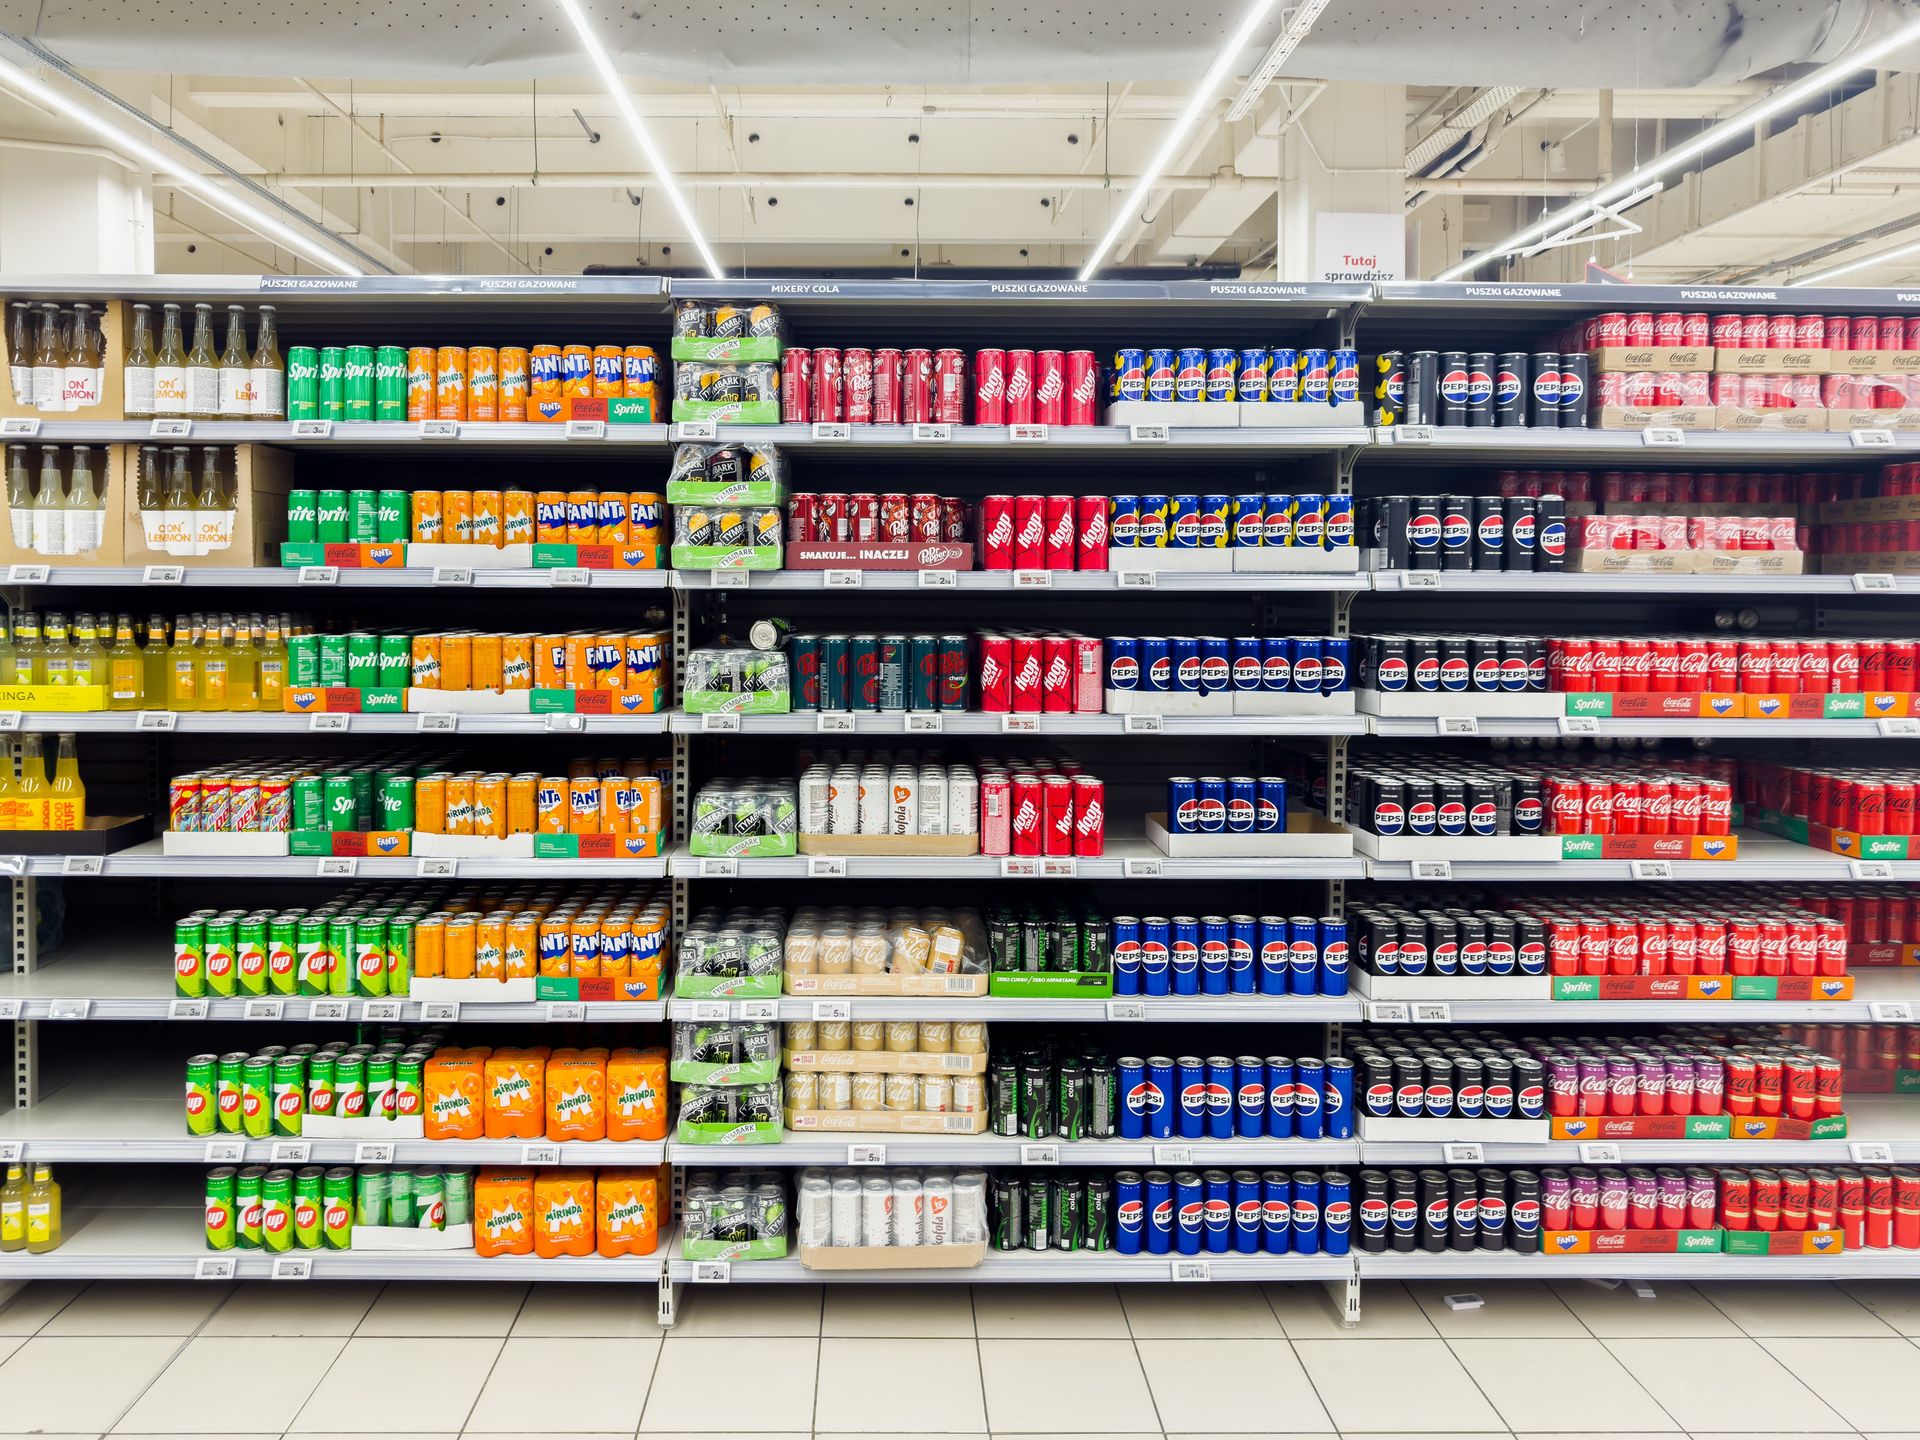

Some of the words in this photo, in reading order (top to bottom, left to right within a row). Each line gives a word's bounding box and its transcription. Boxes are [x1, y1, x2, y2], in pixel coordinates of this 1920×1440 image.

[1343, 256, 1377, 268] Tutaj
[1325, 271, 1393, 282] sprawdzisz
[261, 280, 297, 288] PUSZKI
[480, 281, 516, 289] PUSZKI
[518, 281, 577, 289] GAZOWANE
[771, 285, 810, 293] MIXERY
[812, 285, 839, 293] COLA
[992, 284, 1027, 293] PUSZKI
[1028, 285, 1088, 293] GAZOWANE
[1210, 286, 1247, 294] PUSZKI
[1249, 286, 1307, 295] GAZOWANE
[1466, 287, 1501, 297] PUSZKI
[1503, 289, 1561, 297] GAZOWANE
[1681, 291, 1716, 299] PUSZKI
[1718, 292, 1777, 300] GAZOWANE
[69, 380, 84, 389] ON
[159, 380, 174, 389] ON
[539, 402, 562, 413] FANTA
[614, 403, 645, 416] Sprite
[370, 548, 393, 559] FANTA
[622, 550, 645, 561] FANTA
[721, 549, 753, 566] TYMBARK
[860, 550, 909, 559] INACZEJ
[920, 550, 948, 564] Pepper
[294, 694, 316, 703] FANTA
[366, 694, 398, 706] Sprite
[620, 695, 643, 705] FANTA
[722, 694, 752, 711] TYMBARK
[1711, 698, 1733, 707] FANTA
[1874, 696, 1896, 706] FANTA
[1575, 699, 1604, 711] Sprite
[1759, 699, 1780, 709] FANTA
[1829, 698, 1860, 711] Sprite
[377, 837, 399, 847] FANTA
[625, 838, 646, 848] FANTA
[1564, 841, 1595, 853] Sprite
[1704, 841, 1726, 849] FANTA
[1870, 841, 1901, 854] Sprite
[624, 982, 647, 992] FANTA
[1562, 982, 1592, 993] Sprite
[1700, 981, 1721, 990] FANTA
[1821, 981, 1844, 990] FANTA
[1564, 1121, 1587, 1130] FANTA
[1692, 1122, 1723, 1132] Sprite
[1745, 1122, 1766, 1130] FANTA
[1815, 1123, 1844, 1134] Sprite
[723, 1124, 754, 1143] TYMBARK
[1556, 1235, 1578, 1244] FANTA
[1685, 1235, 1715, 1247] Sprite
[1812, 1235, 1834, 1245] FANTA
